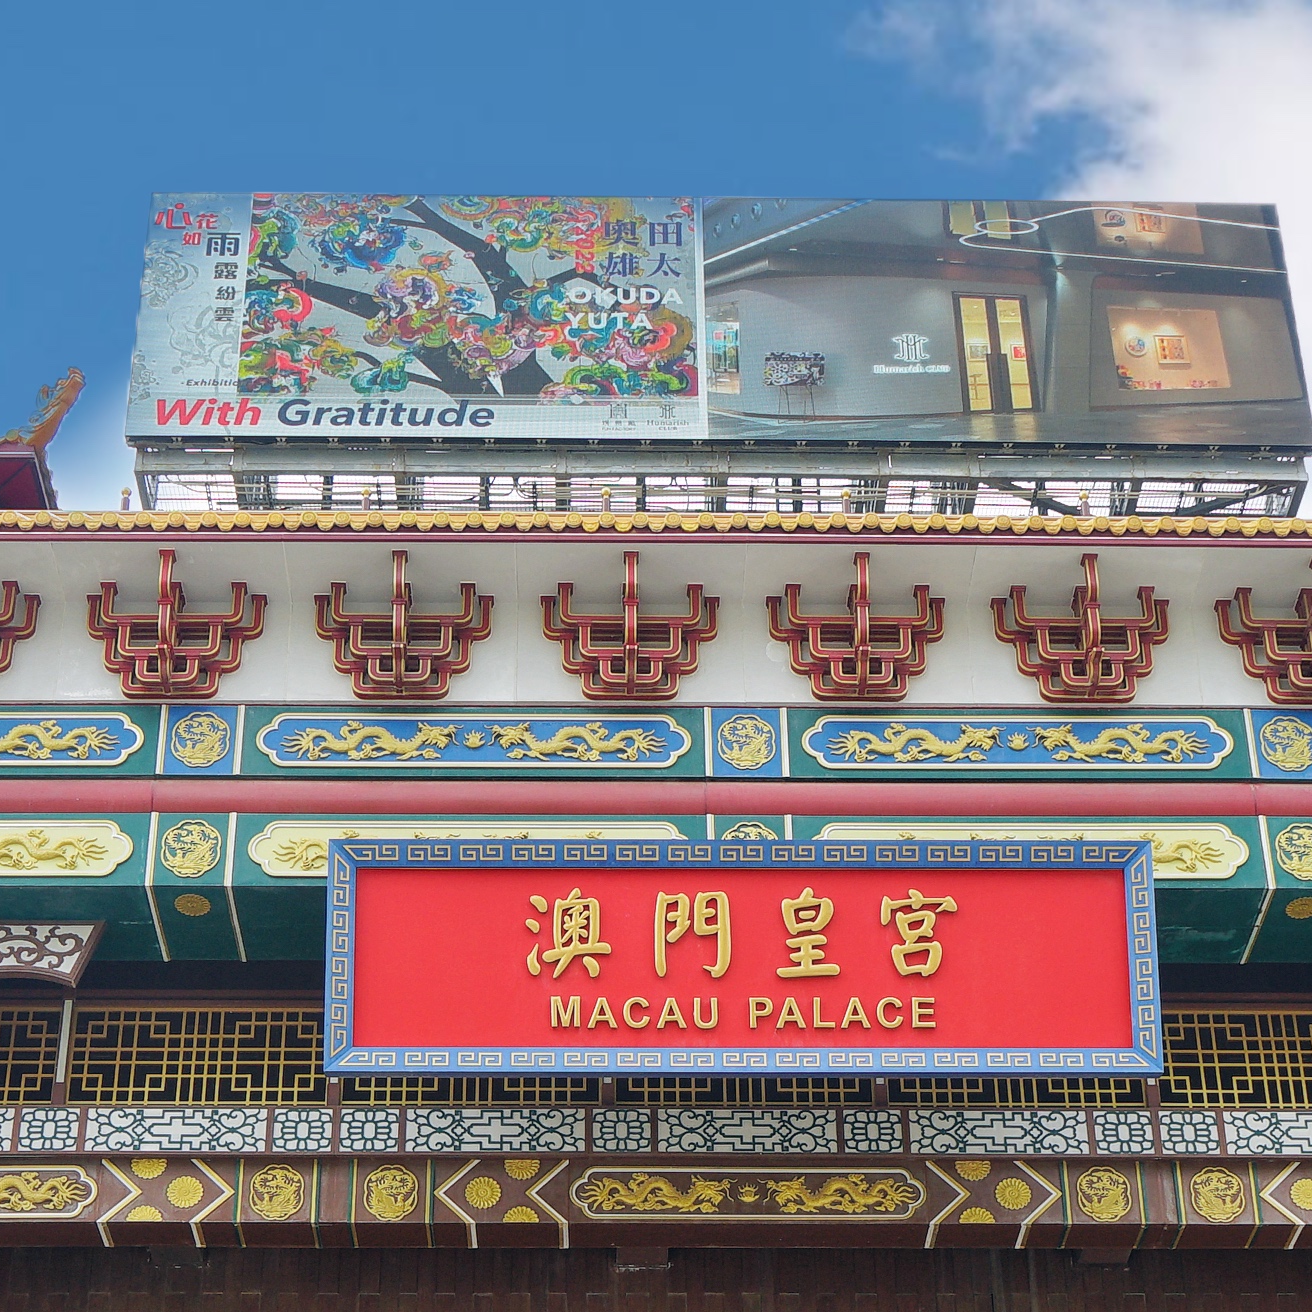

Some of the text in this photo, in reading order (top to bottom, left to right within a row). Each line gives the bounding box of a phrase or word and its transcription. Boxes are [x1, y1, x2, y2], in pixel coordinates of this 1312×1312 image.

[605, 252, 682, 278] 雄太
[567, 287, 683, 304] OKUDA
[156, 398, 495, 428] With Gratitude
[526, 886, 958, 979] 澳門皇宮
[550, 995, 937, 1030] MACAU PALACE
